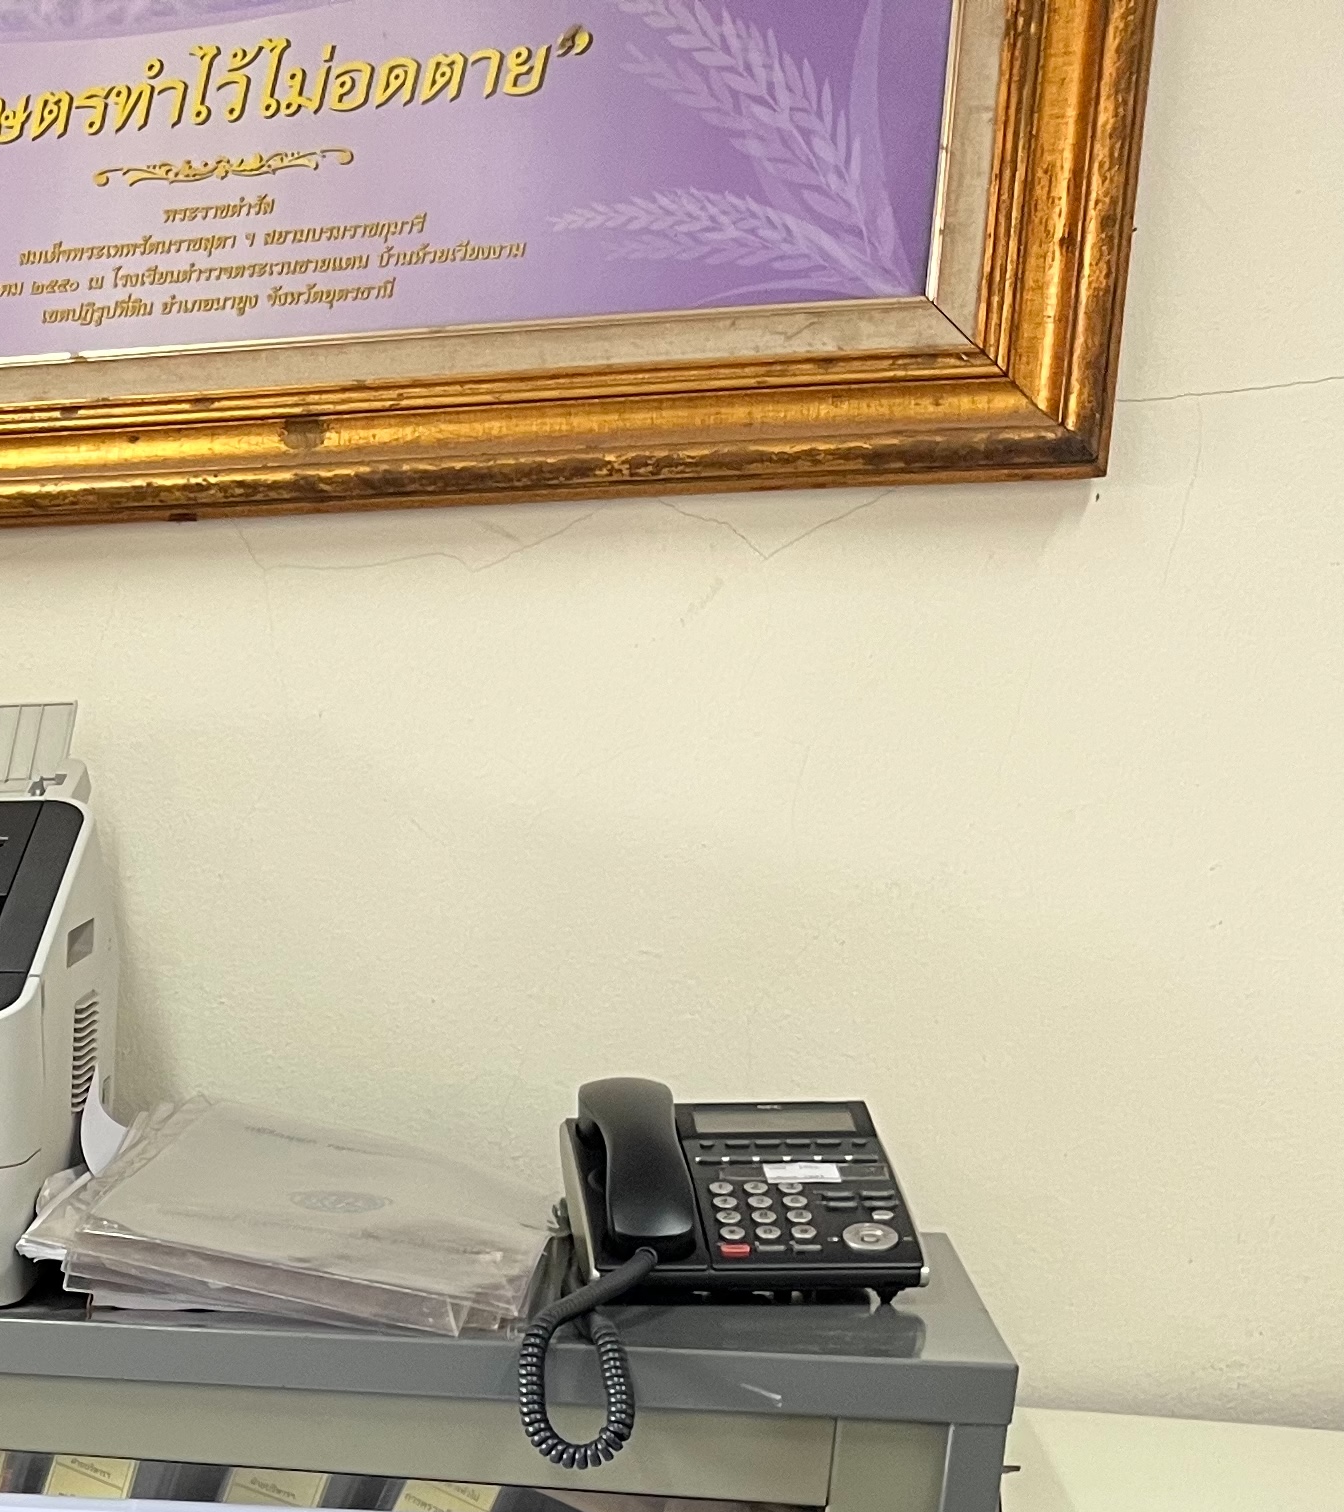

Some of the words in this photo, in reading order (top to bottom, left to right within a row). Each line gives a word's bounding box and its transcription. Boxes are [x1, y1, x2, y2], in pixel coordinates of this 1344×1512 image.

[163, 193, 275, 223] พระราชดำรัส
[263, 211, 428, 247] สยามบรมราชกุมารี
[266, 277, 397, 310] จังหวัดอุดรธานี
